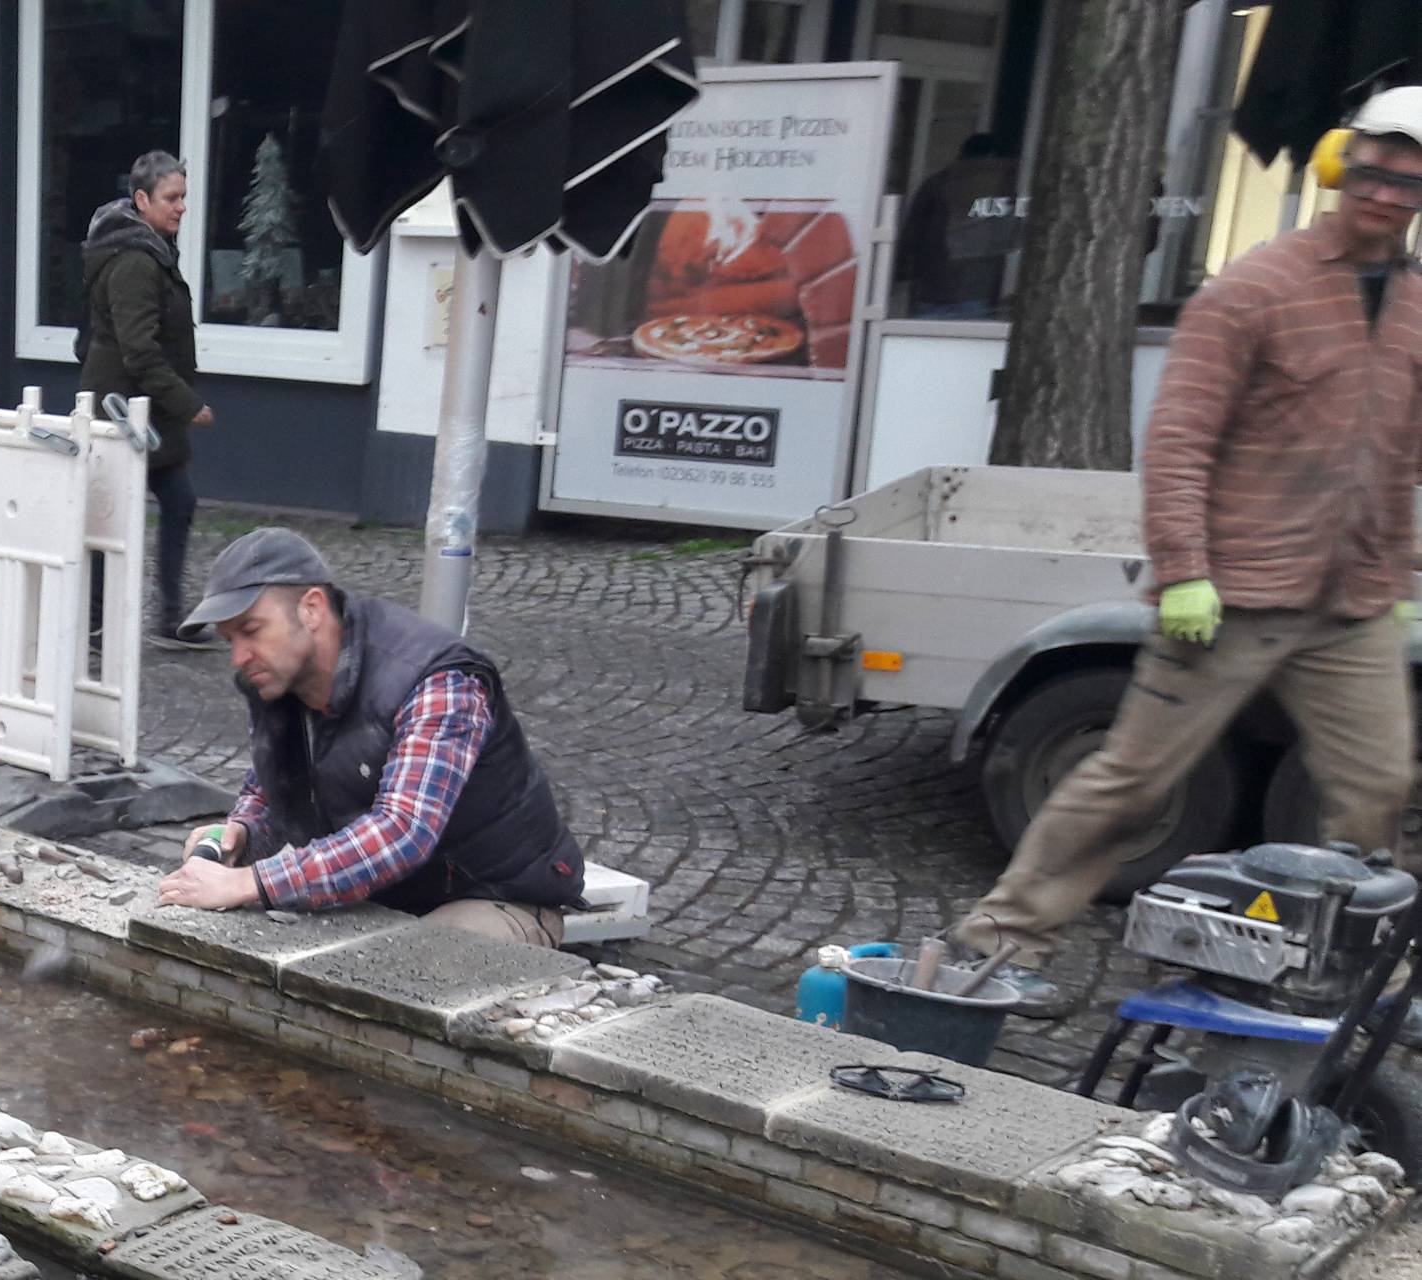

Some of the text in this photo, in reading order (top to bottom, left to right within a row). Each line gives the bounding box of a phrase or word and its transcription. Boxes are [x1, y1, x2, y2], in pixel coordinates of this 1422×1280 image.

[714, 148, 816, 171] HOLZOFEN
[623, 437, 767, 459] PIZZA PASTA BAR
[613, 462, 654, 479] Telefon
